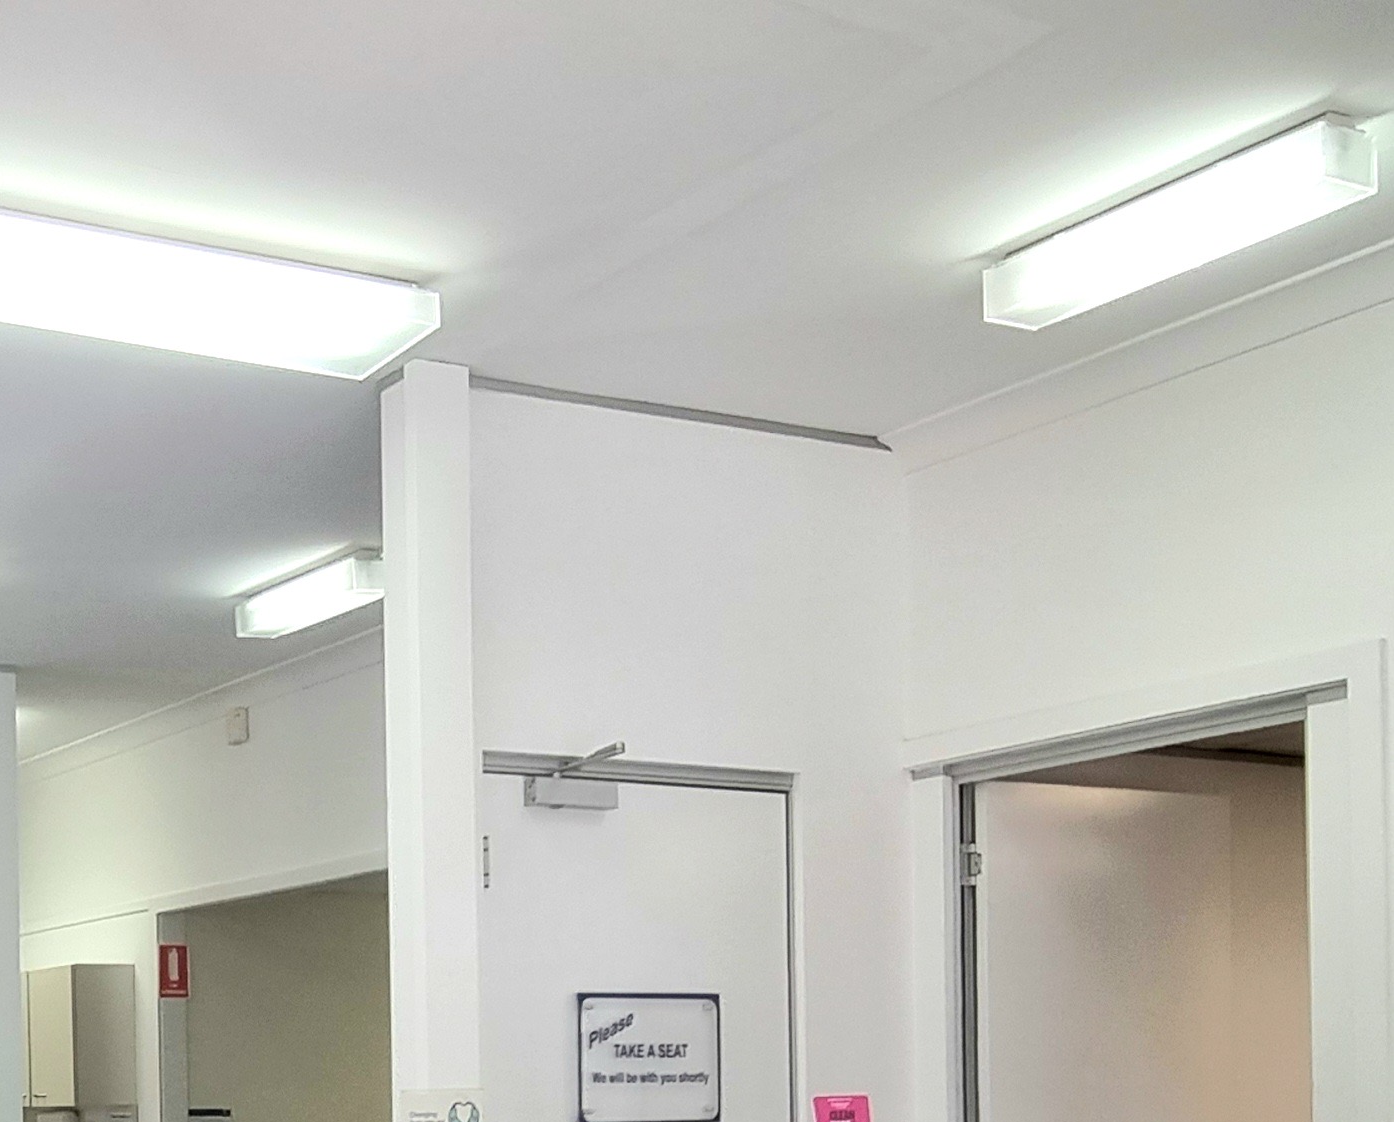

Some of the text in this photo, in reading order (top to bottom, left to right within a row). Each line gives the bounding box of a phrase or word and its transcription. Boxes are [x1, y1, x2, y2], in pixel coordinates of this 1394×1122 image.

[588, 1013, 634, 1050] Please
[613, 1044, 688, 1058] TAKE A SEAT
[591, 1072, 709, 1086] We will be with you shortly
